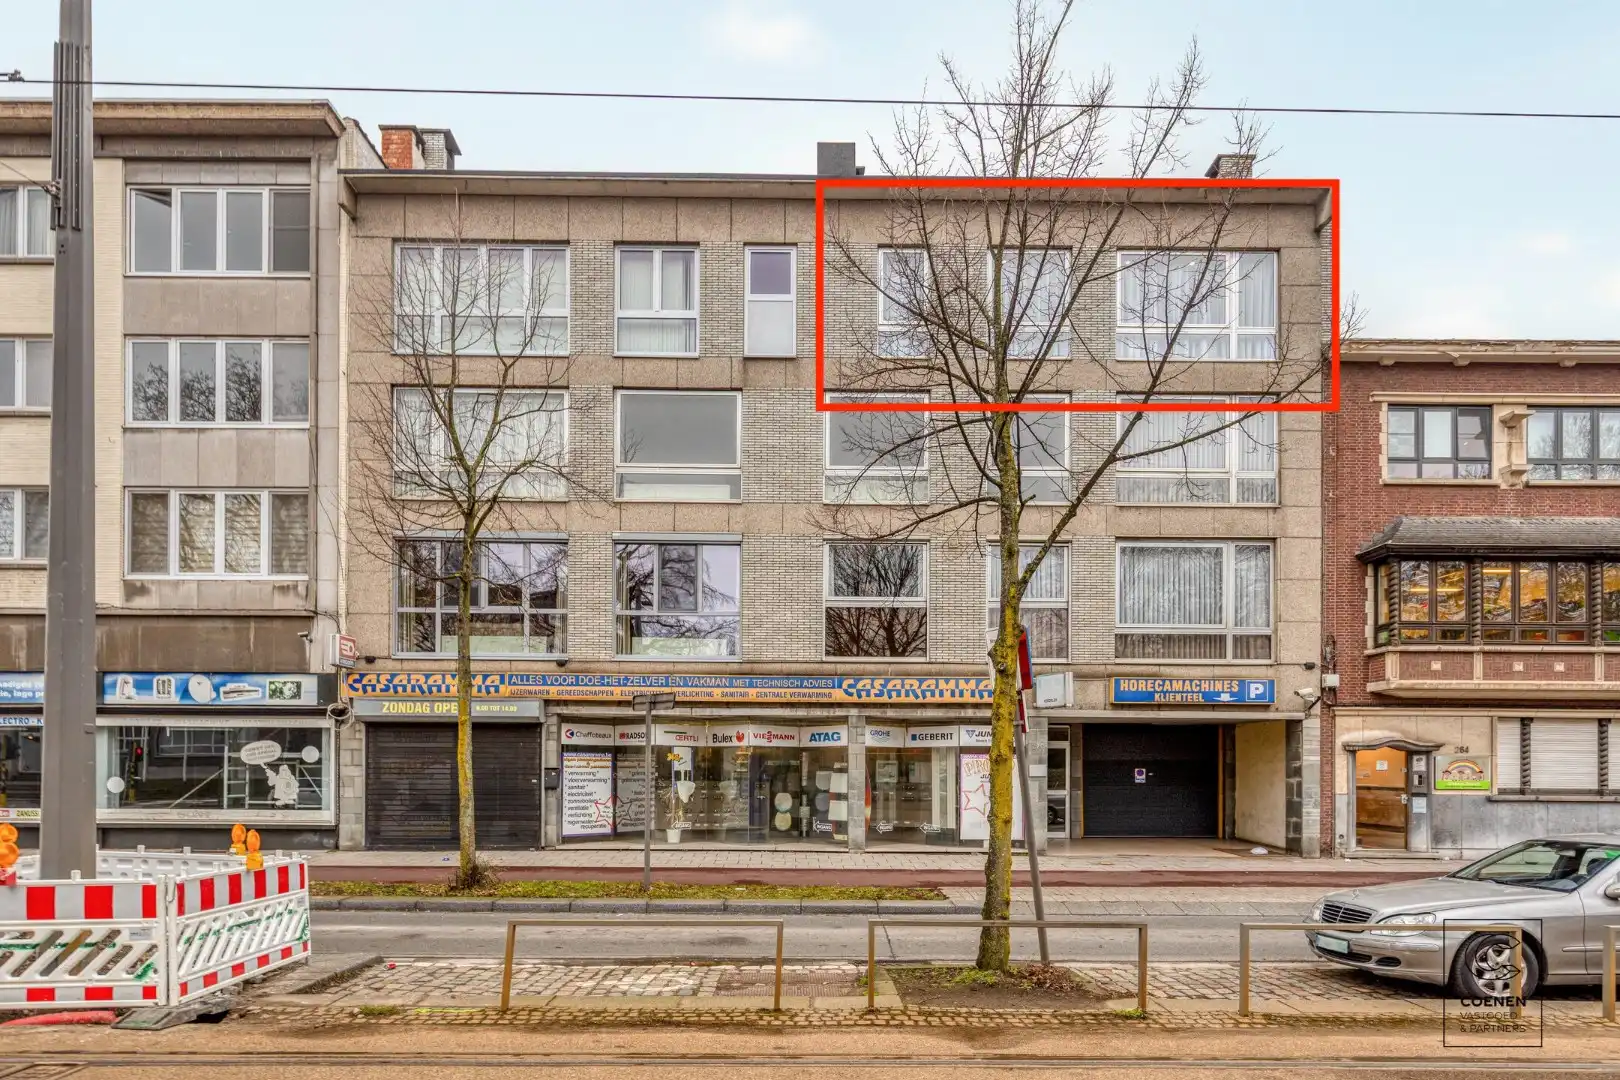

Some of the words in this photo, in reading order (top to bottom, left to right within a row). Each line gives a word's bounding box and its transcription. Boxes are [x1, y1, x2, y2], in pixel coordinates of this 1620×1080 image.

[511, 676, 542, 685] ALLES
[546, 676, 575, 685] VOOR
[579, 676, 666, 686] DOE-HET-ZELVER
[669, 677, 684, 686] EN
[686, 677, 729, 687] VAKMAN
[752, 680, 800, 688] TECHNISCH
[1120, 680, 1239, 692] HORECAMACHINES
[510, 688, 550, 696] IJZERWAREN
[1250, 684, 1264, 699] P
[1154, 693, 1204, 702] KLIENTEEL
[382, 702, 430, 714] ZONDAG
[434, 702, 458, 714] OPE
[576, 730, 612, 739] Chaffoteaux
[712, 733, 733, 743] Bulex
[809, 732, 841, 742] ATAG
[918, 732, 954, 741] GEBERIT
[1454, 746, 1469, 754] 264
